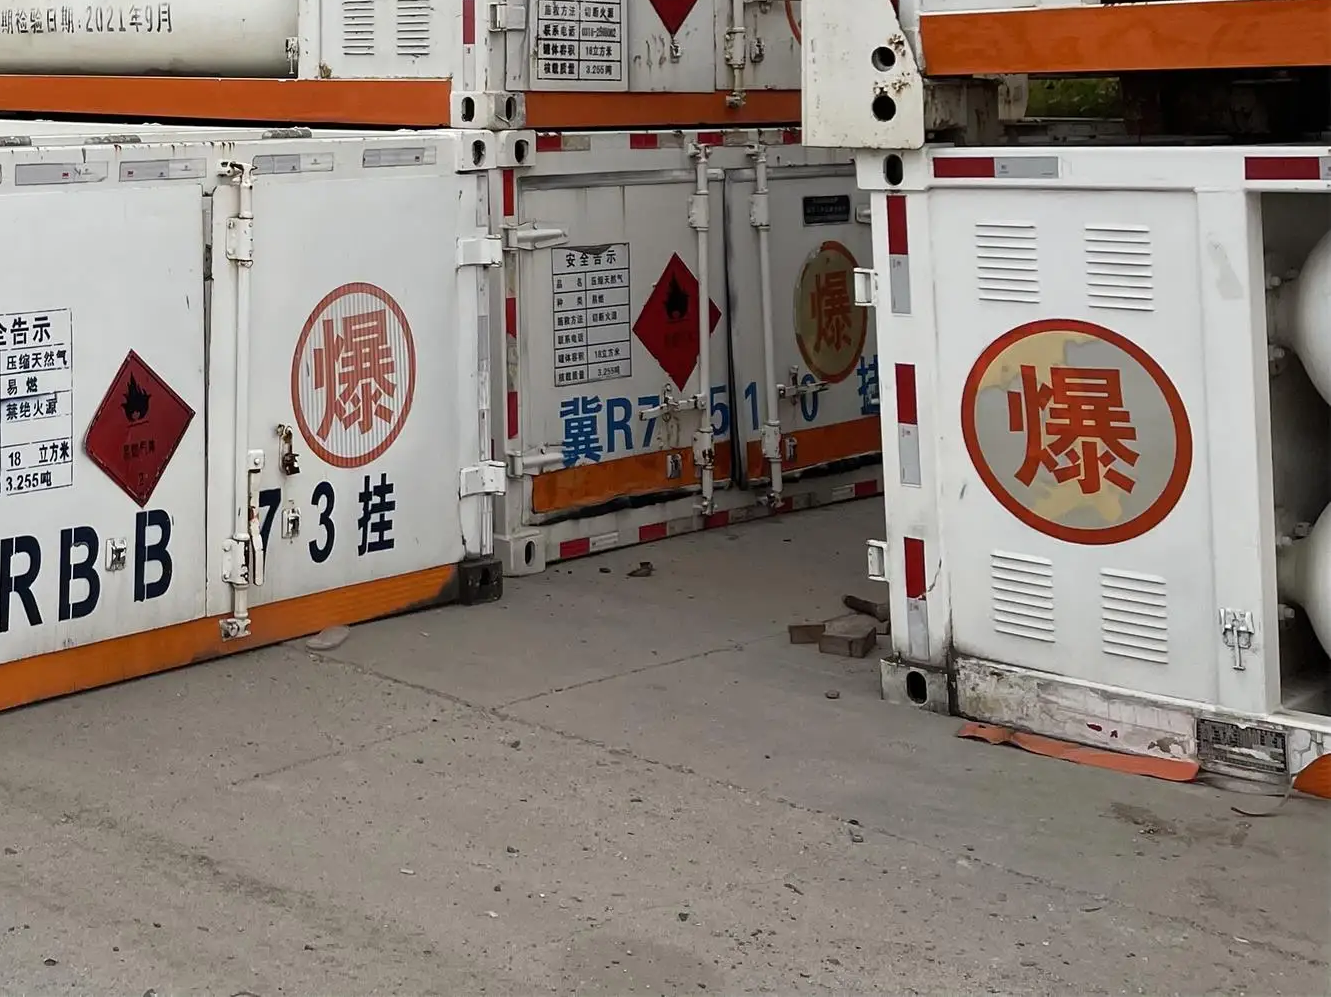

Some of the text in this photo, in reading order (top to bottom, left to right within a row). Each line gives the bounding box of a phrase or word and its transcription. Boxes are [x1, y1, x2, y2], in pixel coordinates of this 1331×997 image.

[543, 24, 576, 37] 联系电话
[809, 270, 852, 353] 爆
[6, 350, 67, 371] 压缩天然气
[7, 376, 38, 396] 易燃
[313, 307, 397, 444] 爆
[1007, 364, 1140, 495] 爆
[8, 451, 21, 467] 18
[38, 440, 70, 464] 立方米
[5, 470, 53, 492] 3.255吨
